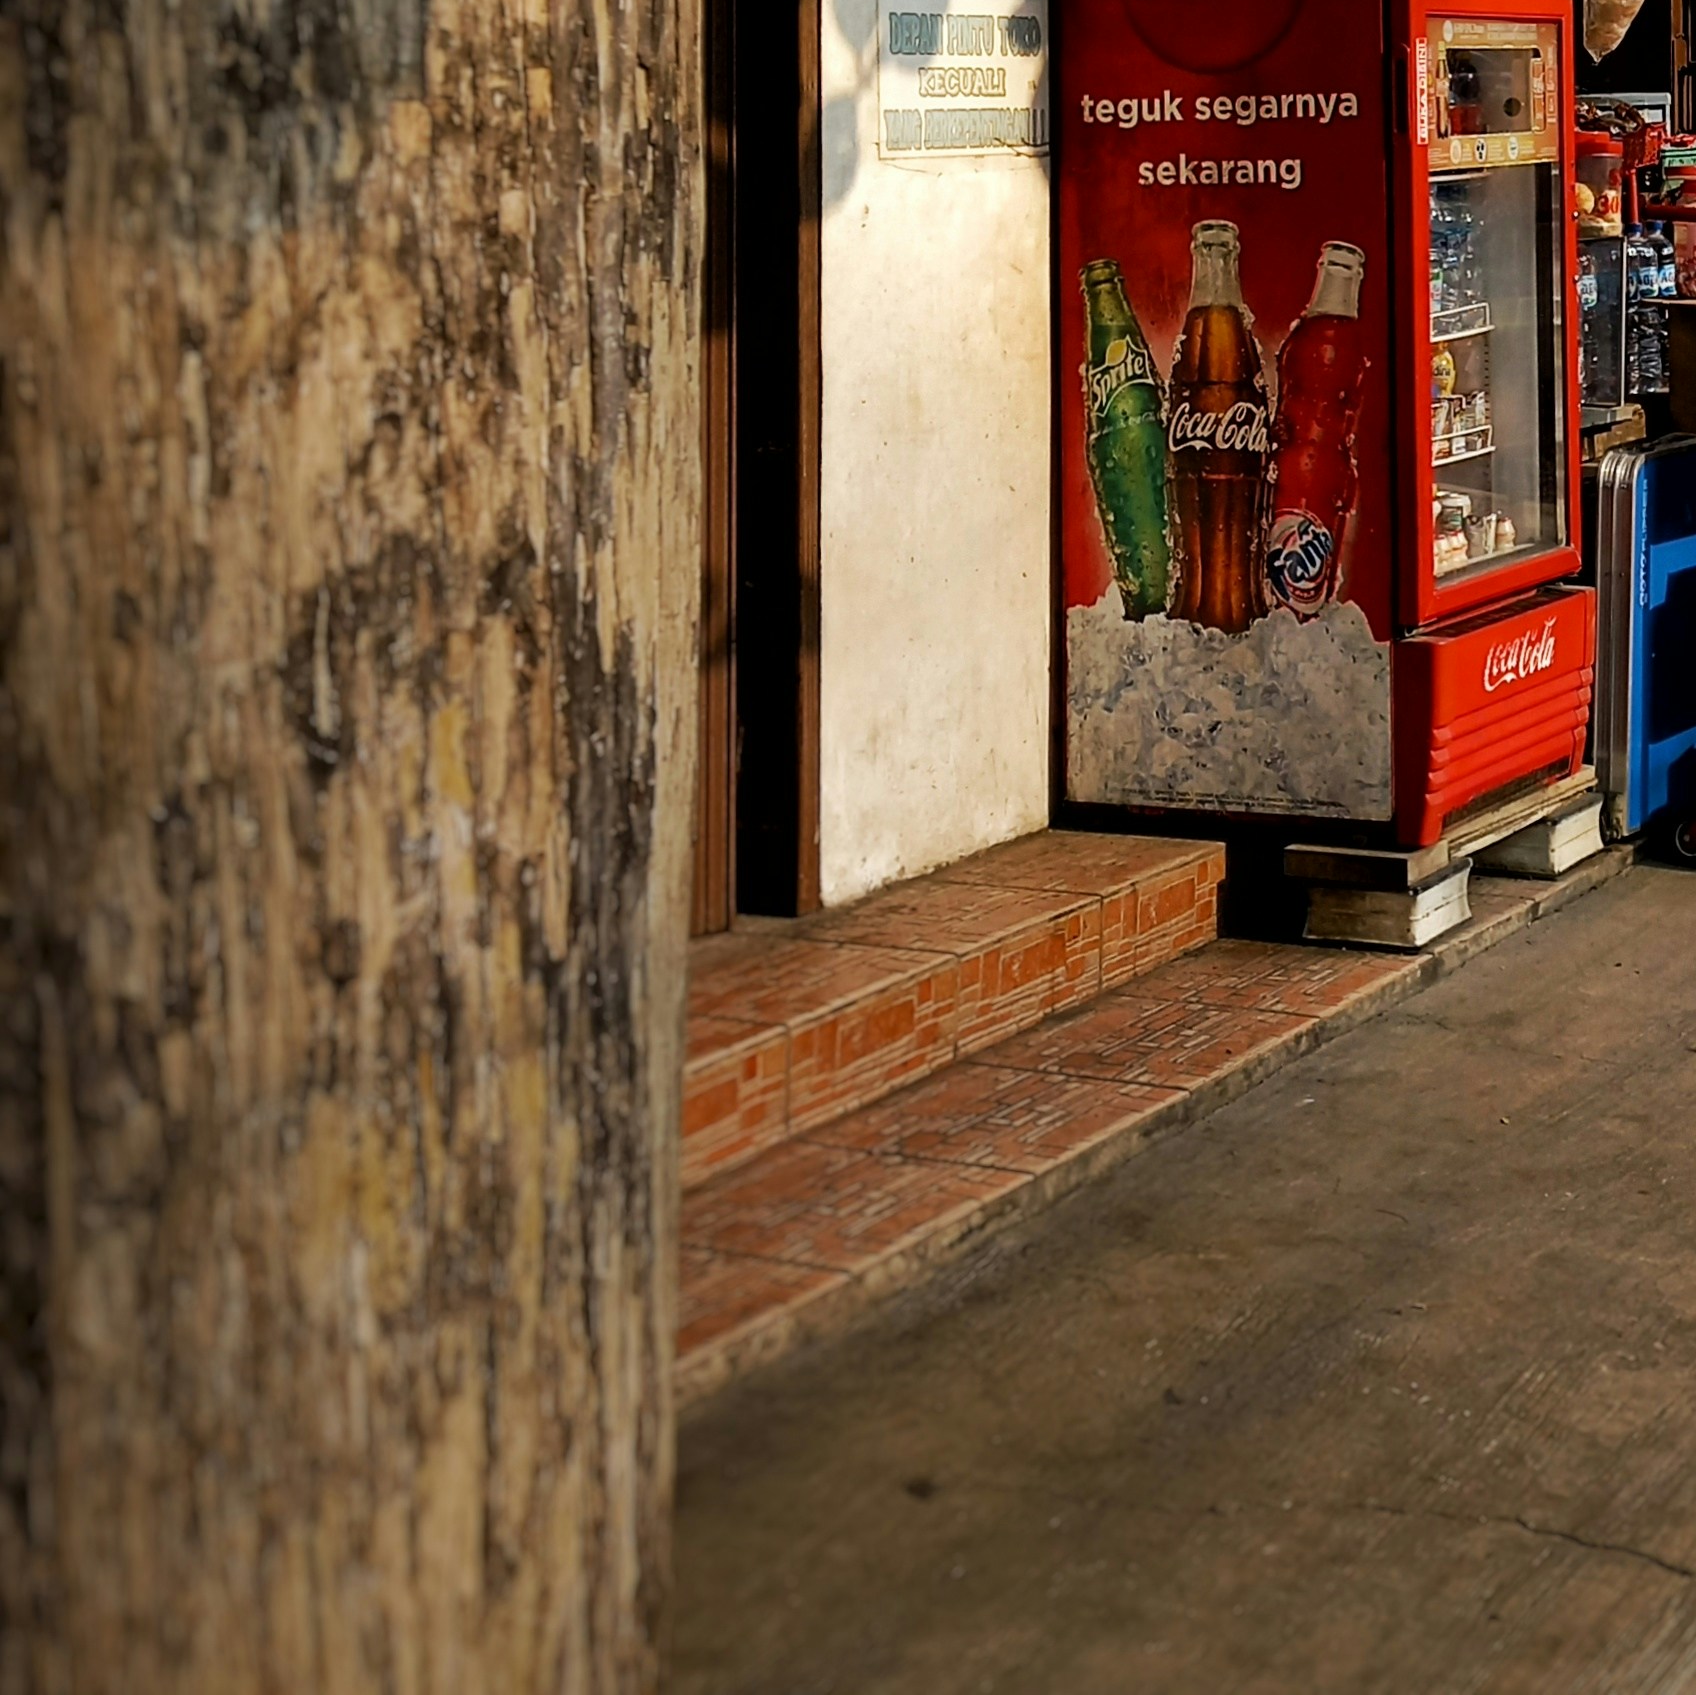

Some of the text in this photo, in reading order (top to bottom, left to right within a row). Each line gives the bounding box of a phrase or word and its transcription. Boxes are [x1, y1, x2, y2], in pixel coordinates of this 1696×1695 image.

[888, 11, 944, 56] DEPAN
[945, 12, 995, 57] PINTU
[918, 66, 1008, 98] KECUALI
[1080, 87, 1359, 129] teguk segarnya
[1137, 152, 1302, 190] sekarang
[1091, 347, 1146, 412] Sprite
[1168, 401, 1271, 453] Coca-Cola
[1482, 616, 1558, 693] Coca-Cola
